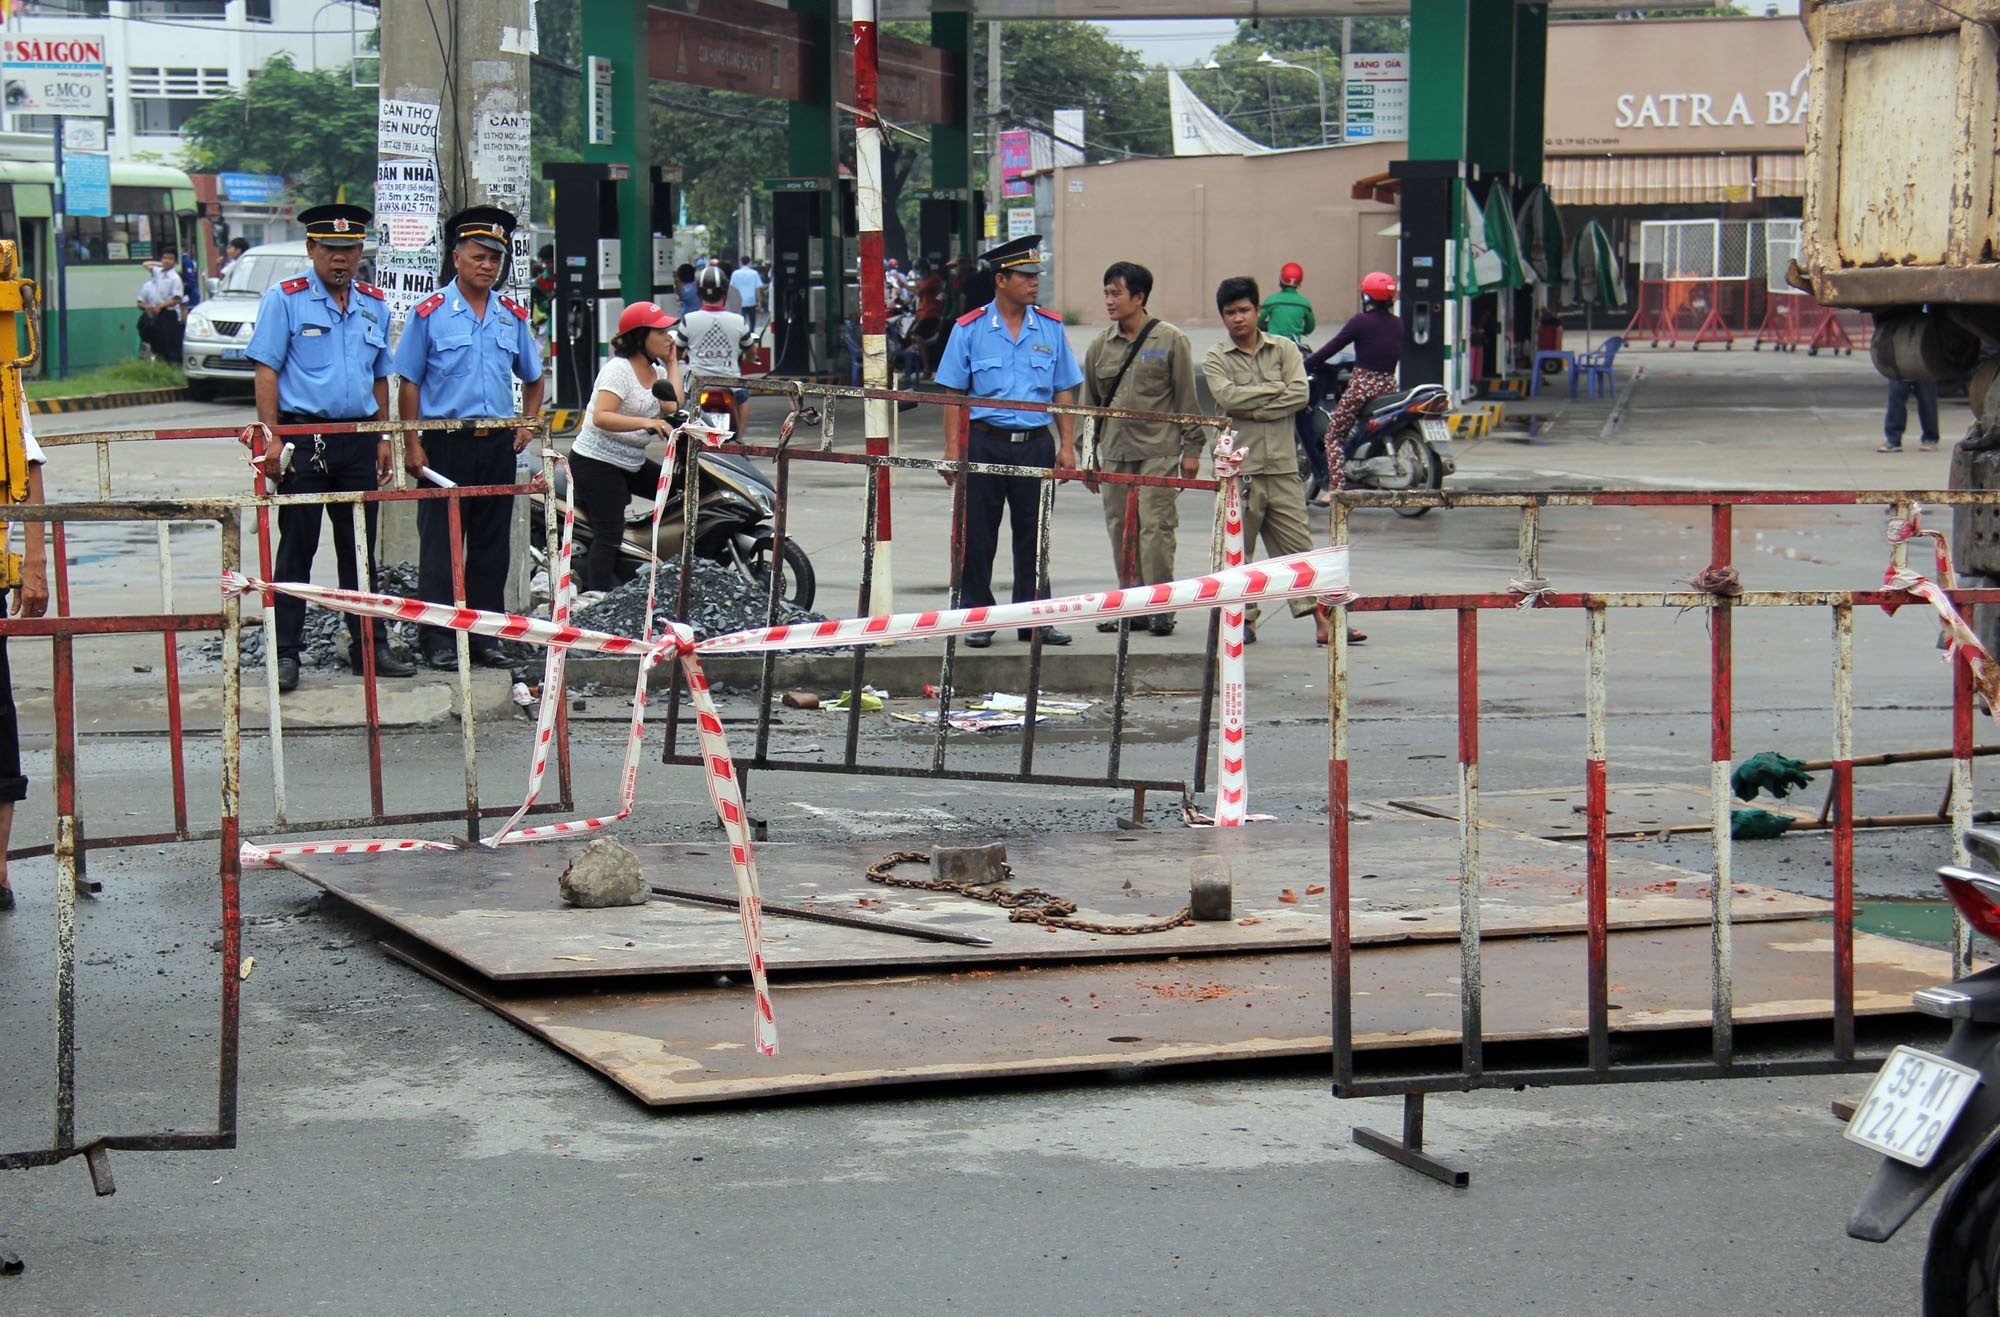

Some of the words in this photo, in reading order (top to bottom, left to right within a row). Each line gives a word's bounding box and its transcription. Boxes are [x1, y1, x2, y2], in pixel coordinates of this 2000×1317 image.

[44, 82, 92, 98] EMCO
[1615, 93, 1755, 128] SATRA
[378, 163, 397, 181] BÁN
[404, 163, 434, 182] NHÀ
[376, 267, 397, 290] BÁN
[403, 271, 434, 293] NHÀ
